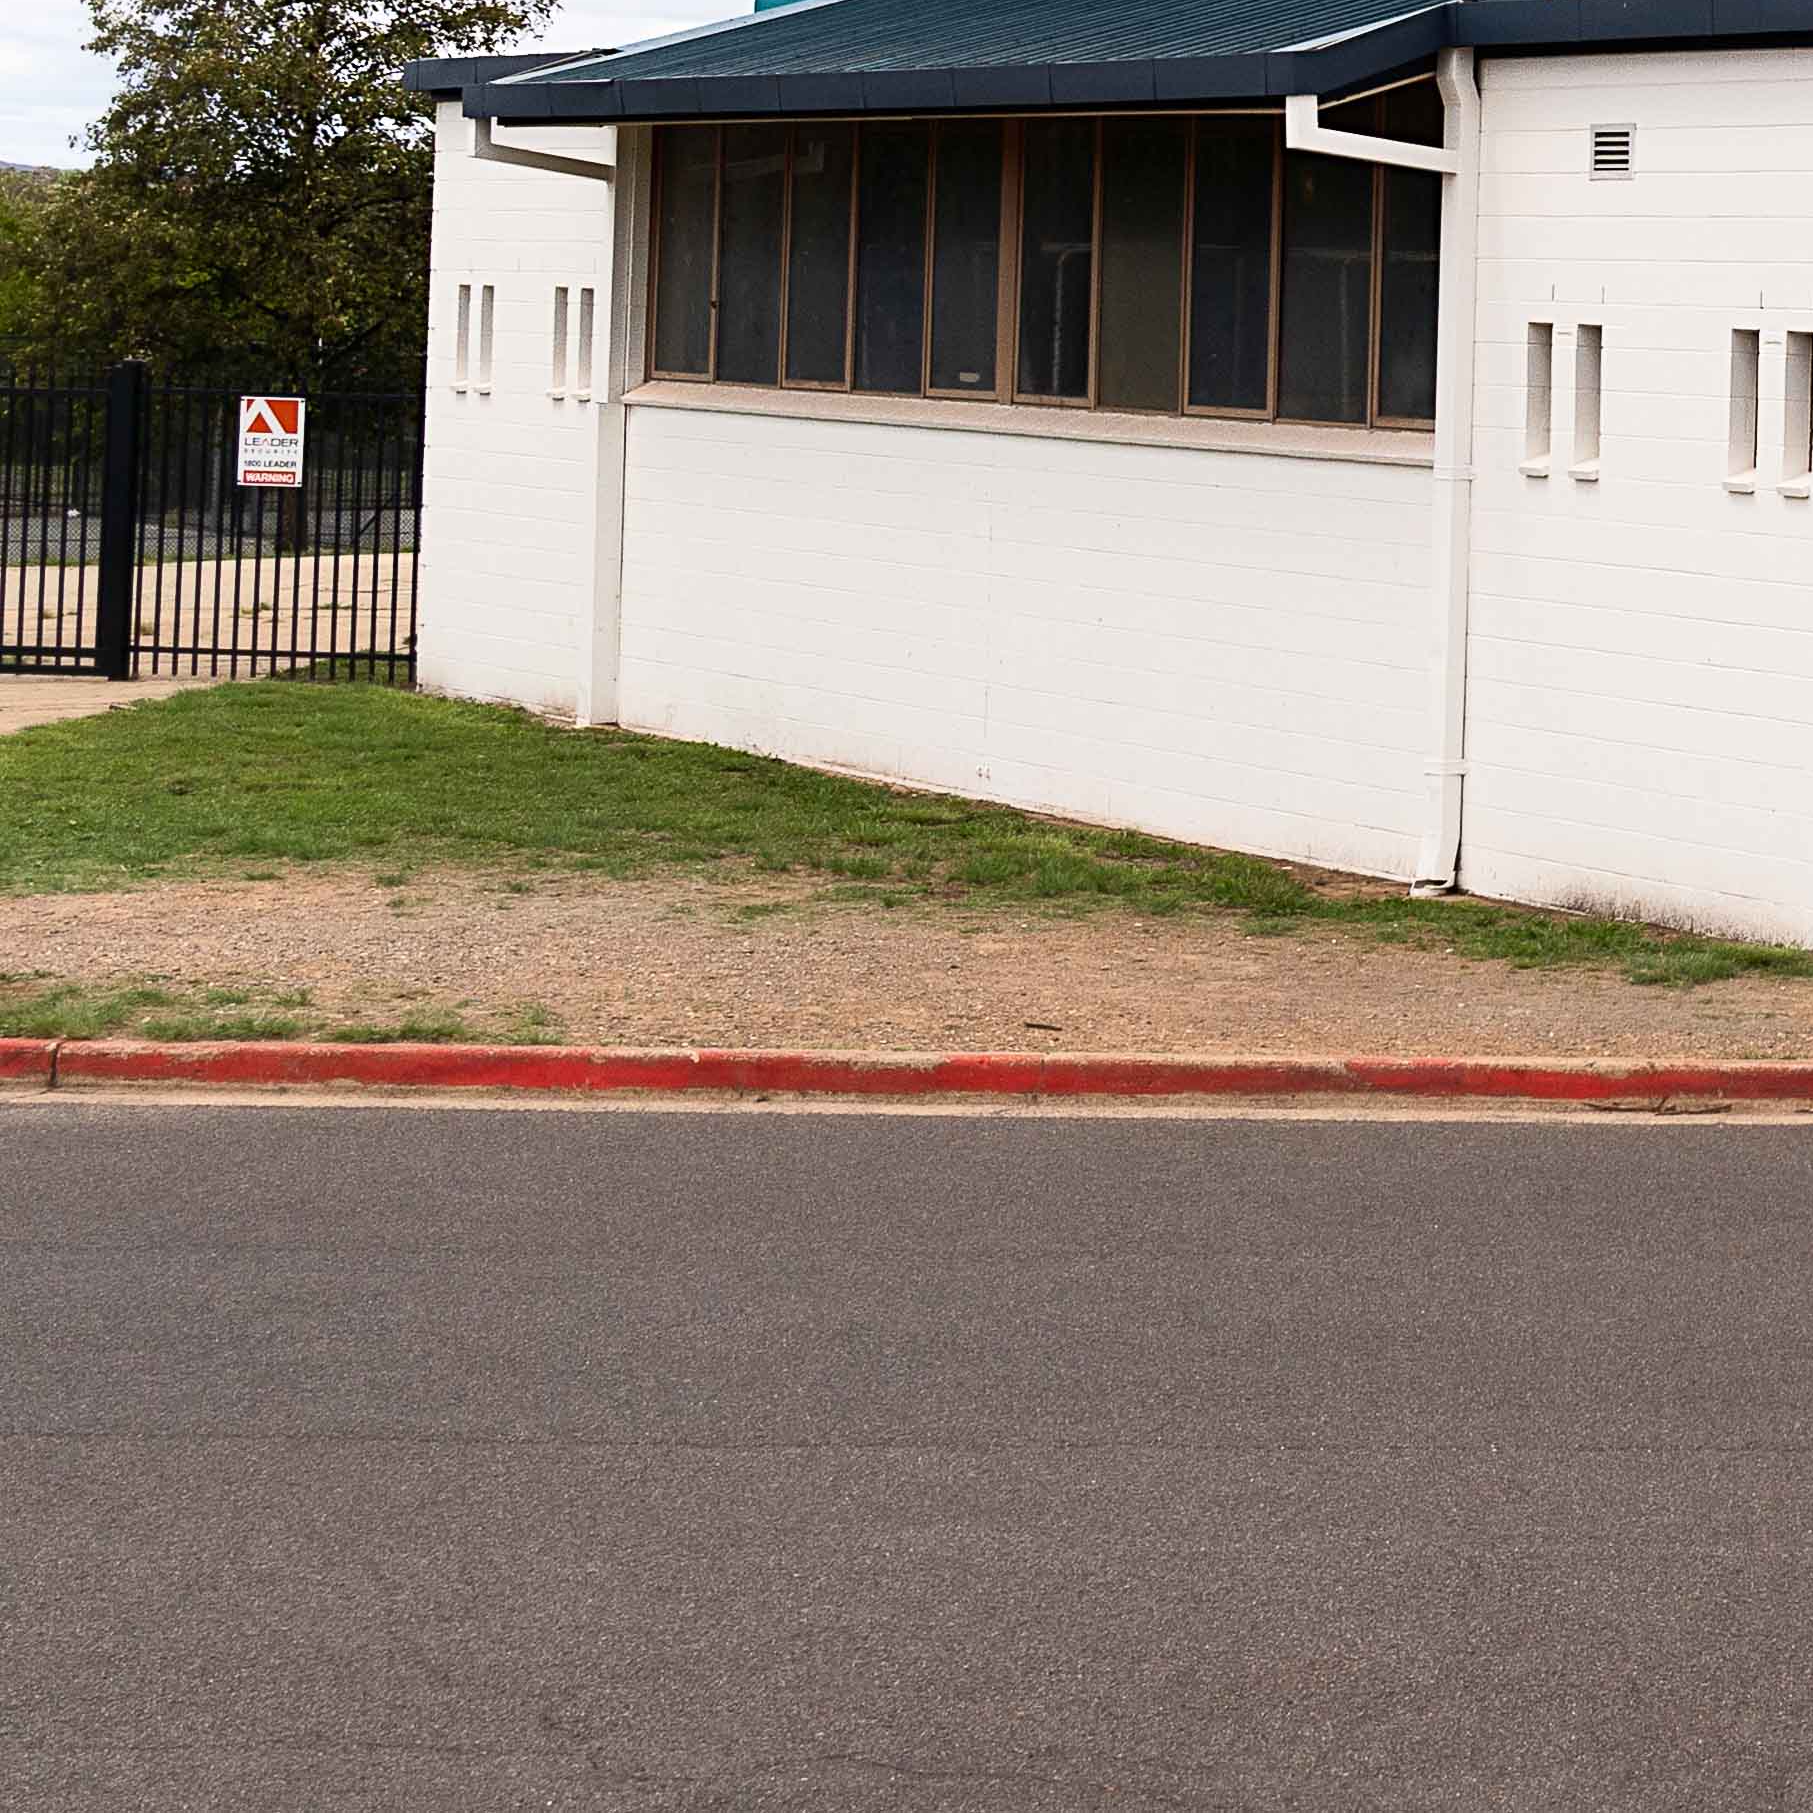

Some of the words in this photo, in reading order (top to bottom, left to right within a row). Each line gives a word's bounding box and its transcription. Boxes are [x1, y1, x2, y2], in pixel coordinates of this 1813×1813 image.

[244, 437, 298, 447] LEADER
[263, 460, 297, 468] LEADER
[246, 472, 294, 483] WARNING
